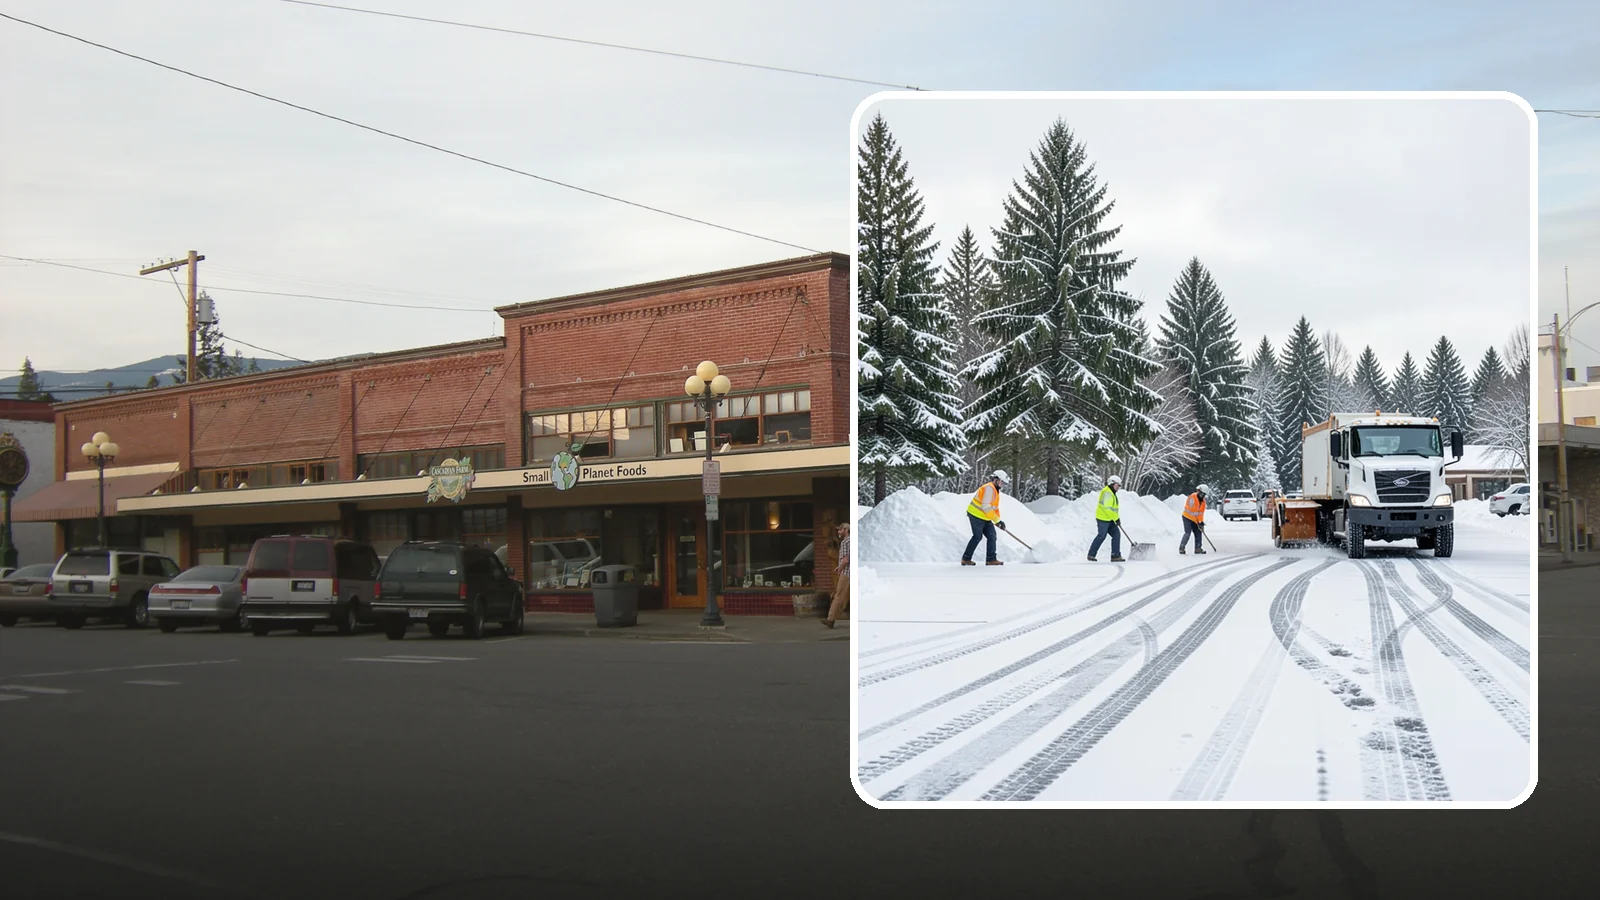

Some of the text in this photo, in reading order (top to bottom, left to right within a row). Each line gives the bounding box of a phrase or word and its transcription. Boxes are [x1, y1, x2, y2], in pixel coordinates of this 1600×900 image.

[523, 464, 647, 483] Small Planet Foods
